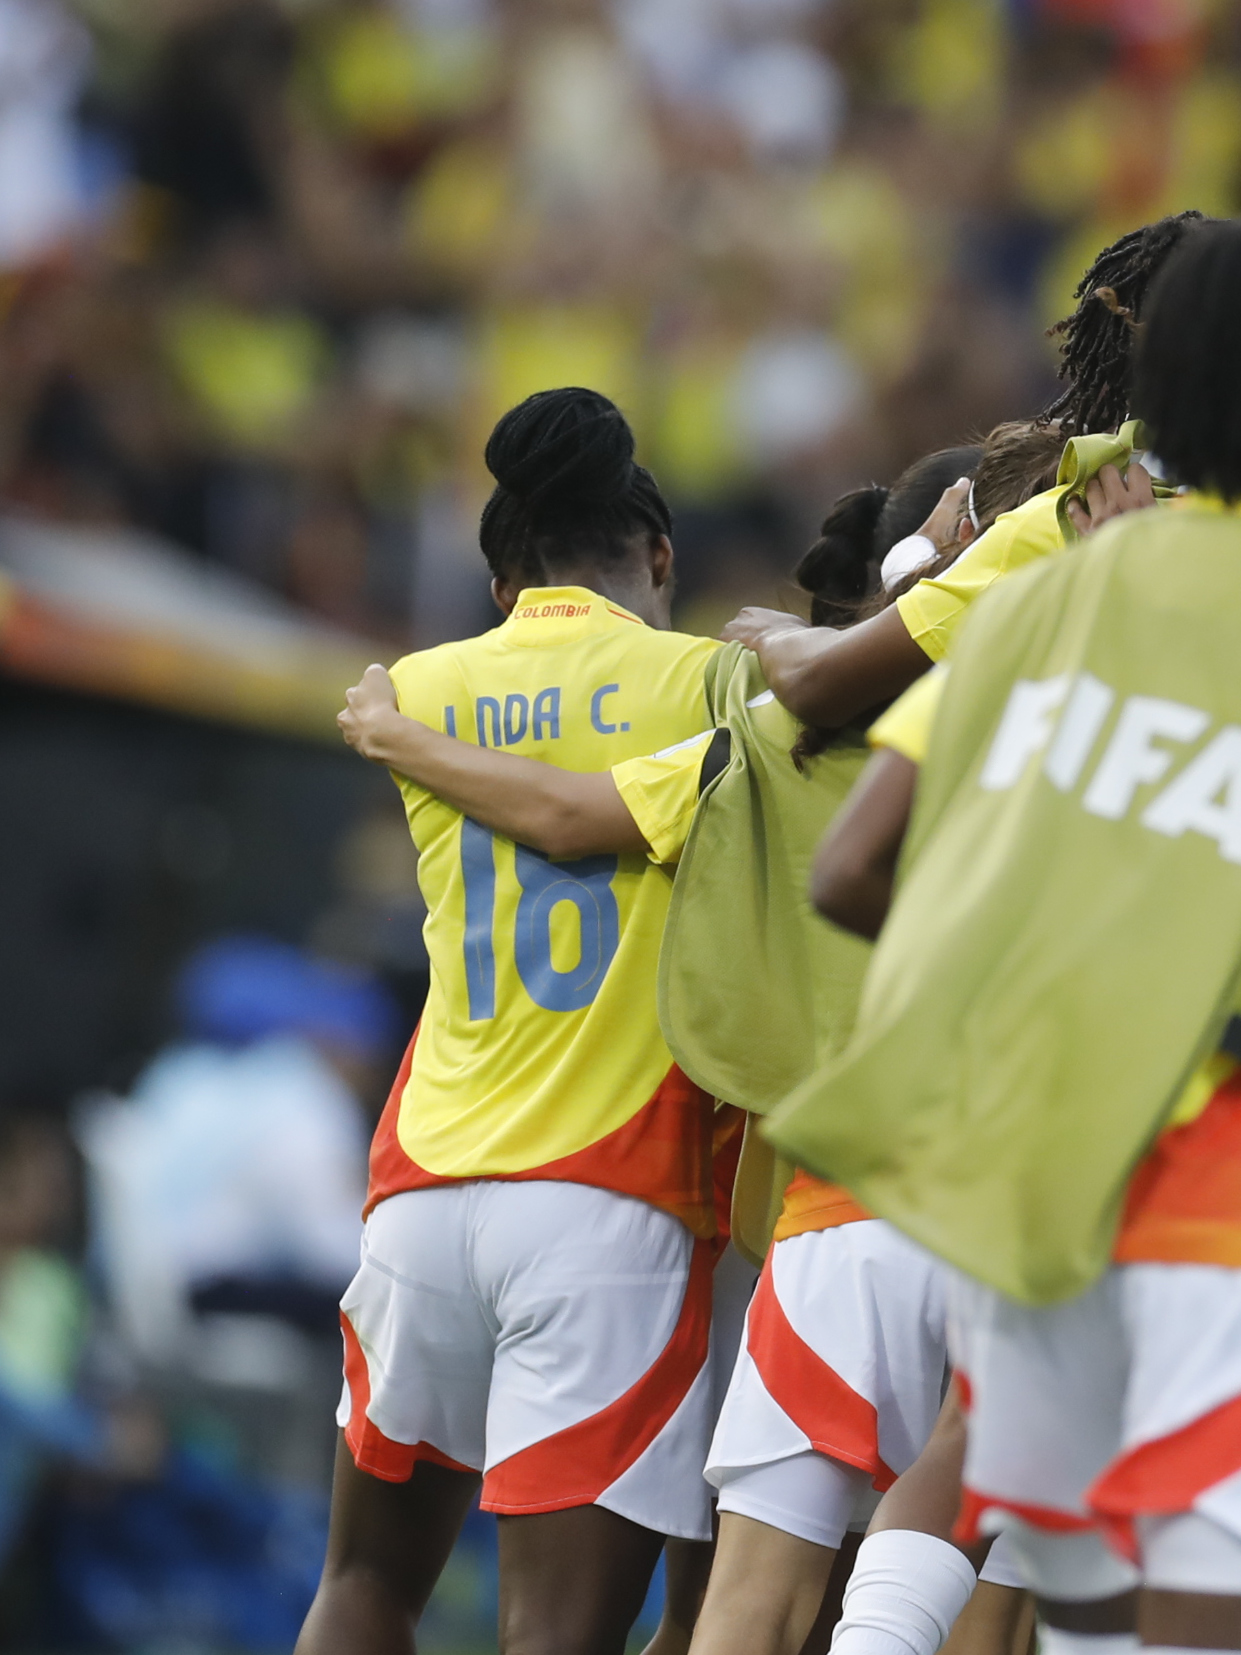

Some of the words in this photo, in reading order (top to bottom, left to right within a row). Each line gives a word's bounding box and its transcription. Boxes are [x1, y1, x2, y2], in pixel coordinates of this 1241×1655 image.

[514, 604, 591, 620] COLOMBIA
[590, 683, 630, 734] C.
[460, 815, 620, 1022] 18
